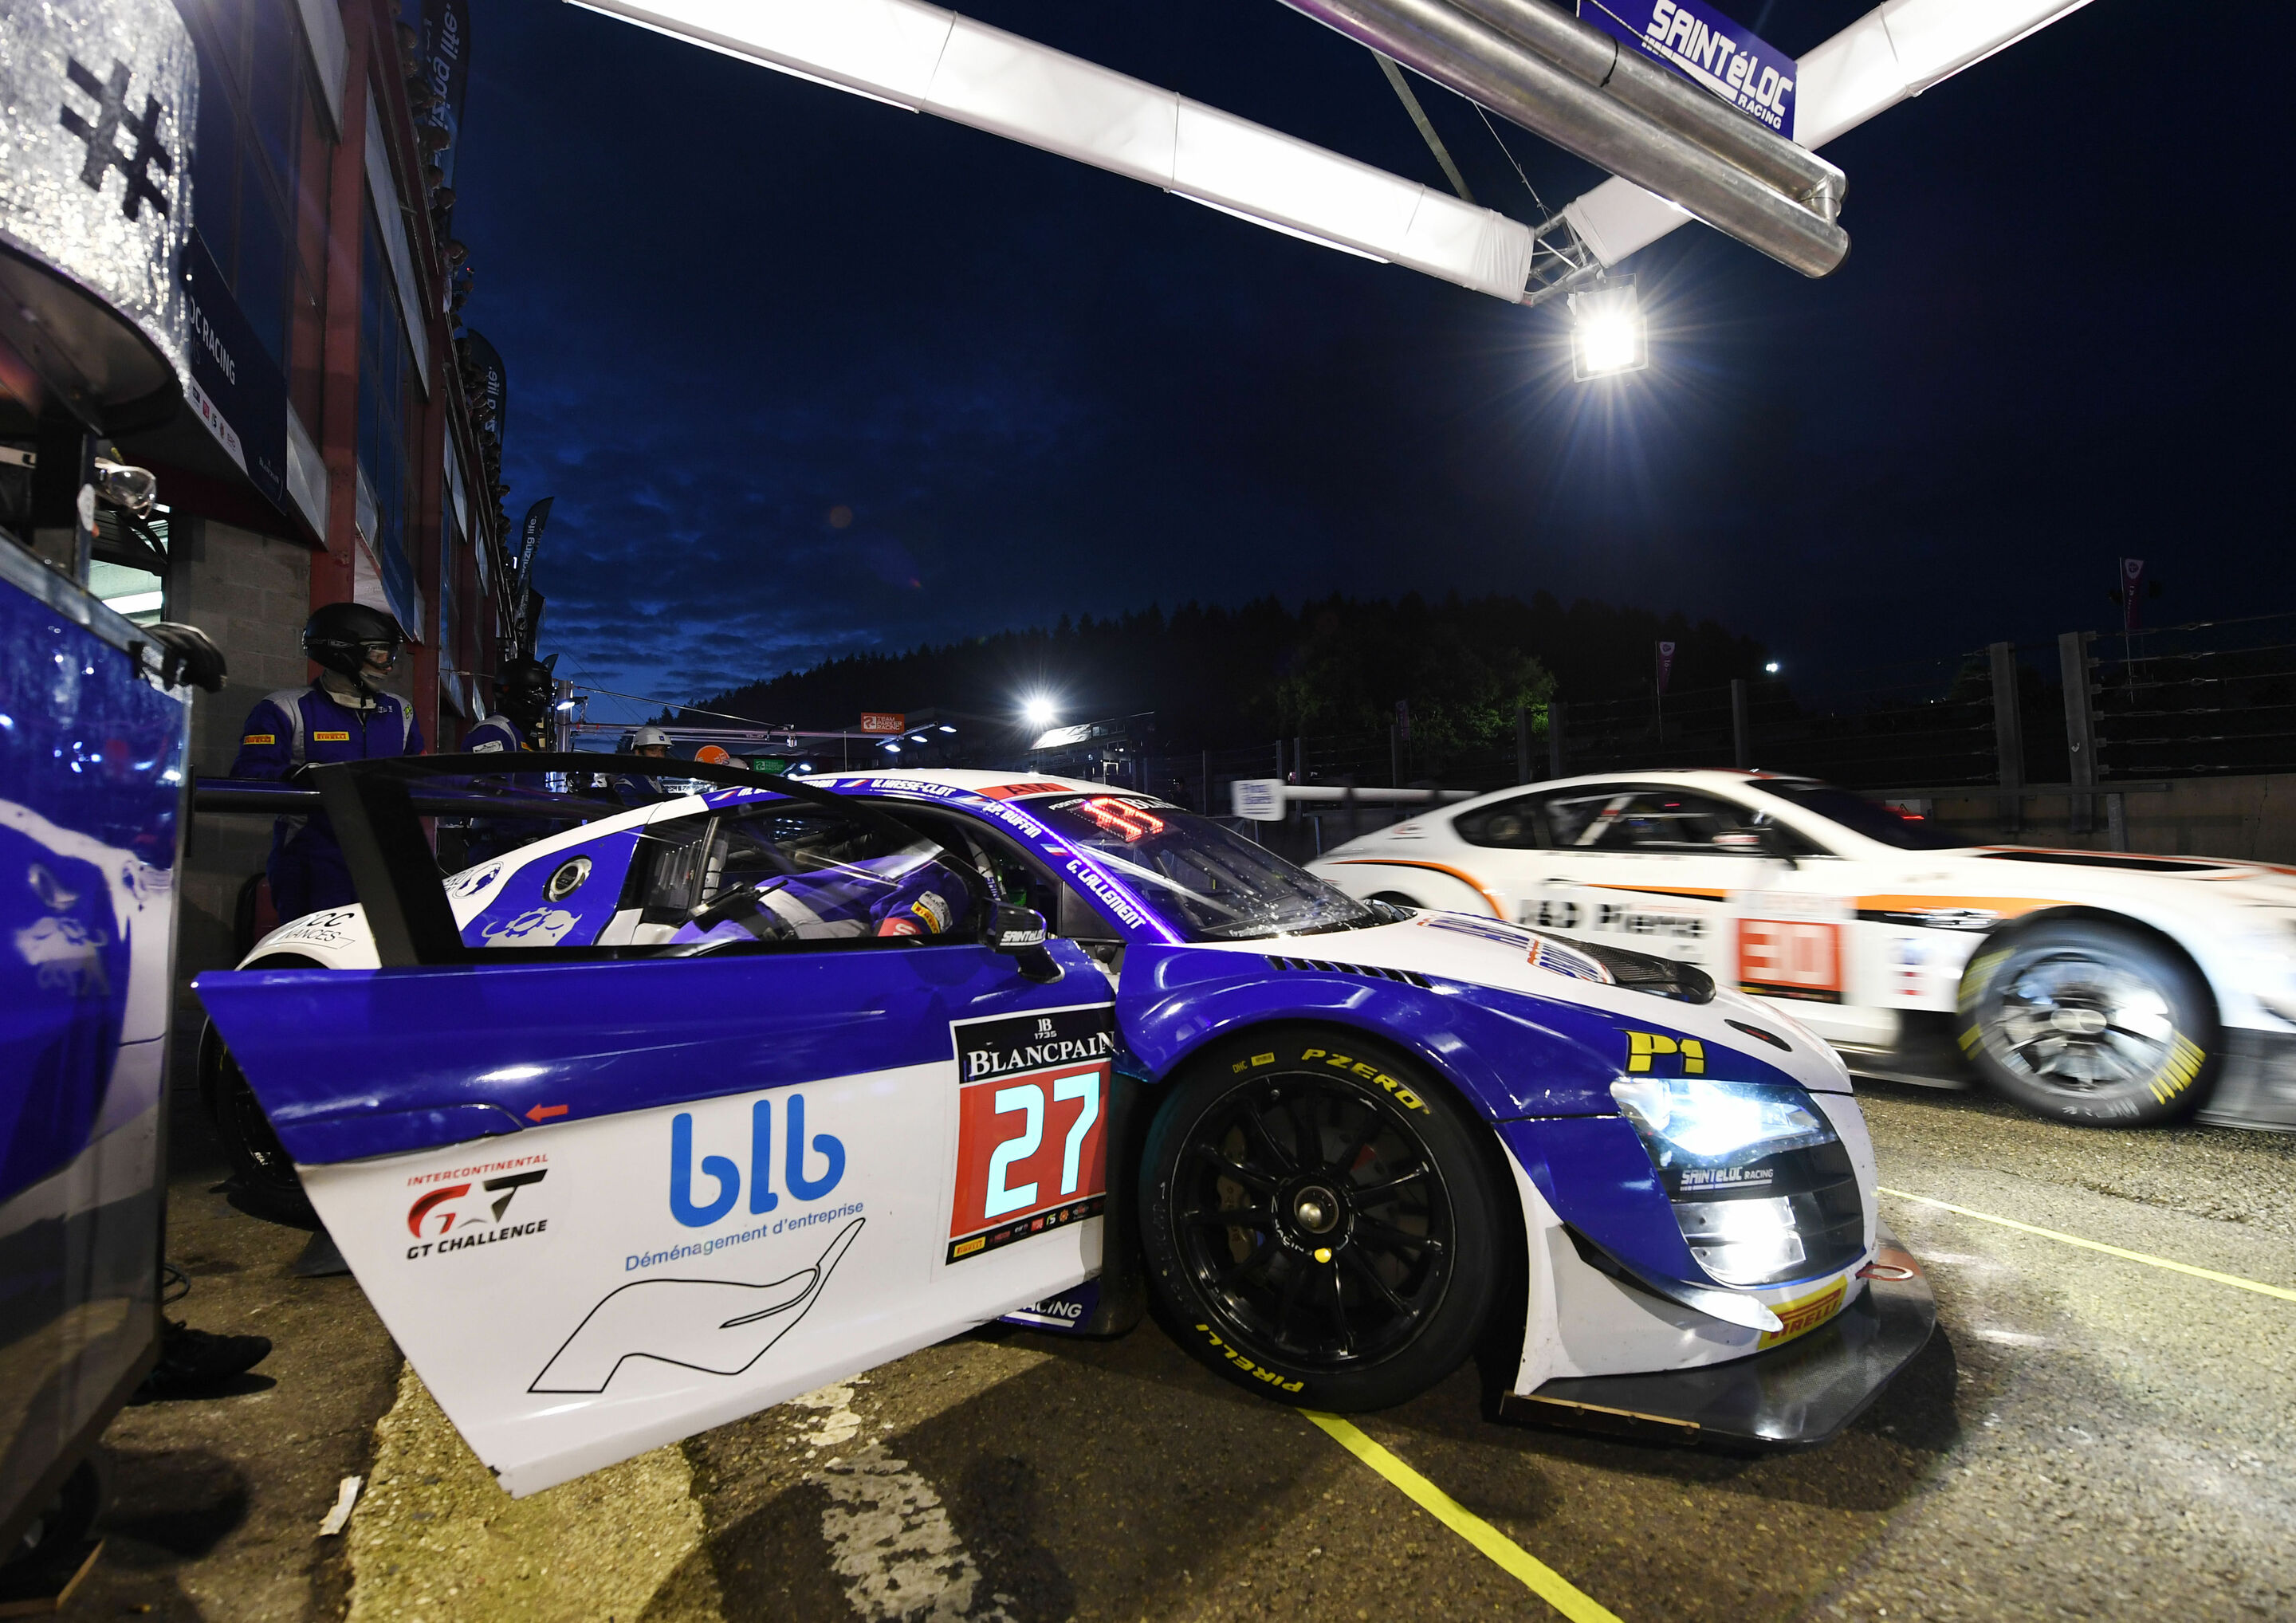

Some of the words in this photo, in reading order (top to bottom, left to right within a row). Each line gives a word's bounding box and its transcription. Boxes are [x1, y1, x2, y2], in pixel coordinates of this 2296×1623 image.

[1738, 93, 1782, 130] RACING
[202, 316, 236, 386] RACING
[1000, 811, 1043, 839] BUFFIN
[1077, 870, 1146, 929] LALLEMENT
[967, 1031, 1115, 1078] BLANCPAIN
[1034, 1031, 1057, 1040] 1735
[670, 1094, 846, 1228] blb
[984, 1071, 1100, 1219] 27
[407, 1154, 548, 1186] INTERCONTINENTAL
[1744, 1168, 1774, 1180] RACING
[407, 1244, 434, 1259] GT
[437, 1219, 548, 1254] CHALLENGE
[625, 1225, 767, 1271] Déménagement
[773, 1202, 863, 1236] d'entreprise
[1021, 1301, 1083, 1318] ACING
[1769, 1287, 1842, 1340] PIRELLI
[1196, 1324, 1305, 1393] PIRELLI
